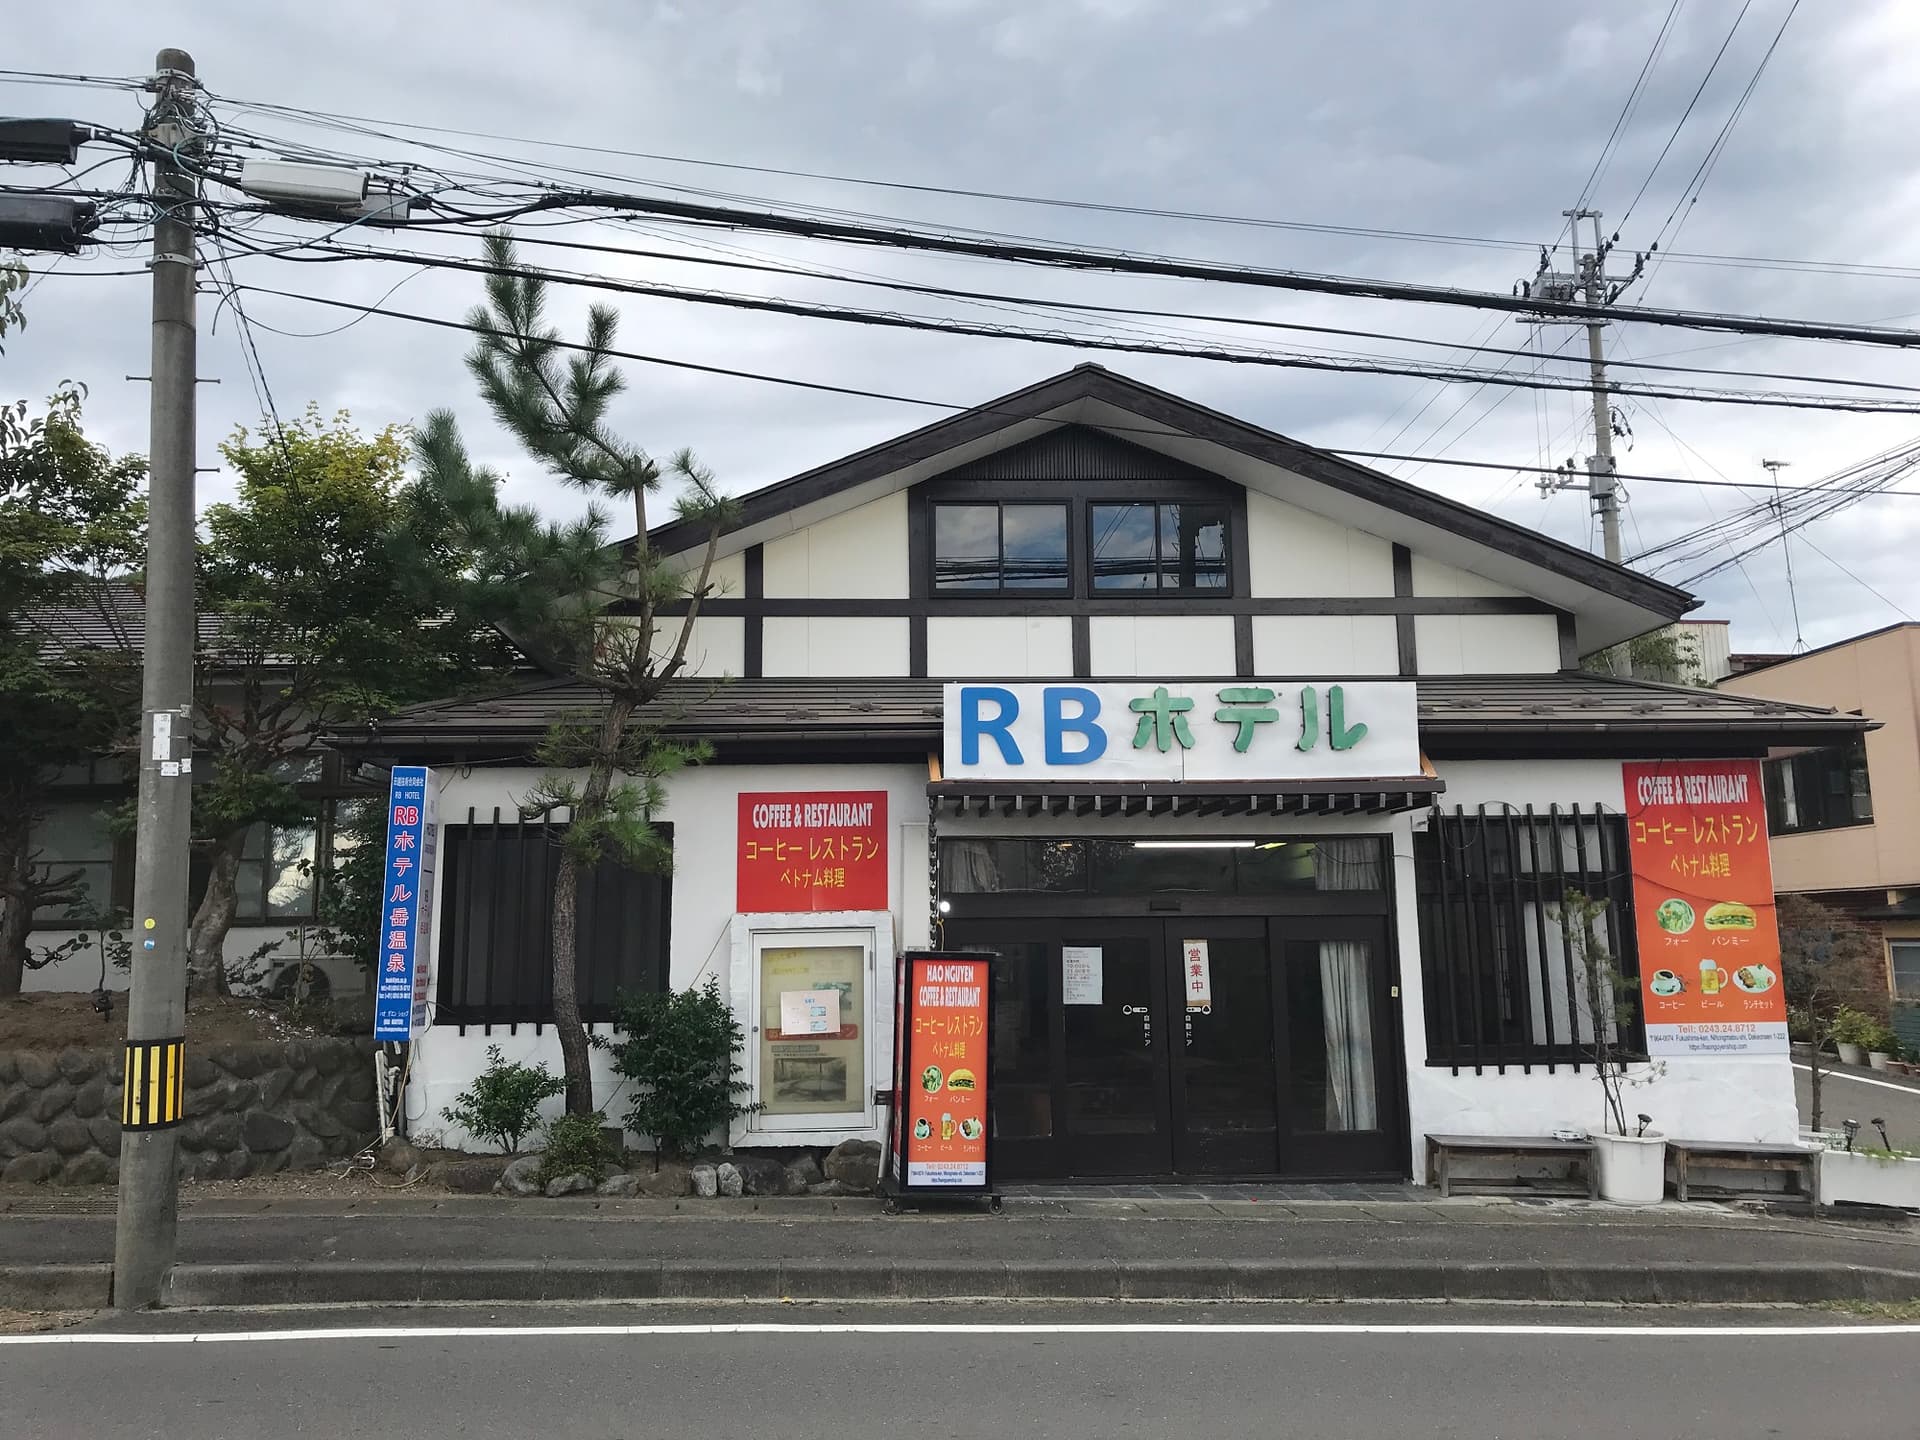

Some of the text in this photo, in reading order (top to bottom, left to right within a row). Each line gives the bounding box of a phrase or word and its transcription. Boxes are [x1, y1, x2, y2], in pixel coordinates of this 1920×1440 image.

[405, 791, 420, 800] HOTEL
[1637, 774, 1749, 806] COFFEE & RESTAURANT
[753, 803, 873, 828] COFFEE & RESTAURANT
[1635, 813, 1758, 845] コーヒー レストラン
[746, 835, 879, 862] コーヒー レストラン
[1671, 852, 1731, 878] ベトナム料理
[780, 867, 845, 889] ベトナム料理
[1664, 937, 1689, 946] フォー
[927, 964, 974, 983] HAO NGUYEN
[1188, 947, 1204, 993] 営業中
[920, 985, 939, 1007] COFFEE
[945, 986, 981, 1008] RESTAURANT
[1659, 1000, 1686, 1009] コーヒー
[1701, 1000, 1724, 1009] ビール
[1743, 999, 1774, 1010] ランチセット
[915, 1015, 984, 1037] コーヒー レストラン
[1143, 1015, 1151, 1047] 自動ドア
[1185, 1015, 1193, 1047] 自動ドア
[1698, 1023, 1756, 1034] 0243.24.8712
[932, 1041, 966, 1060] ベトナム料理
